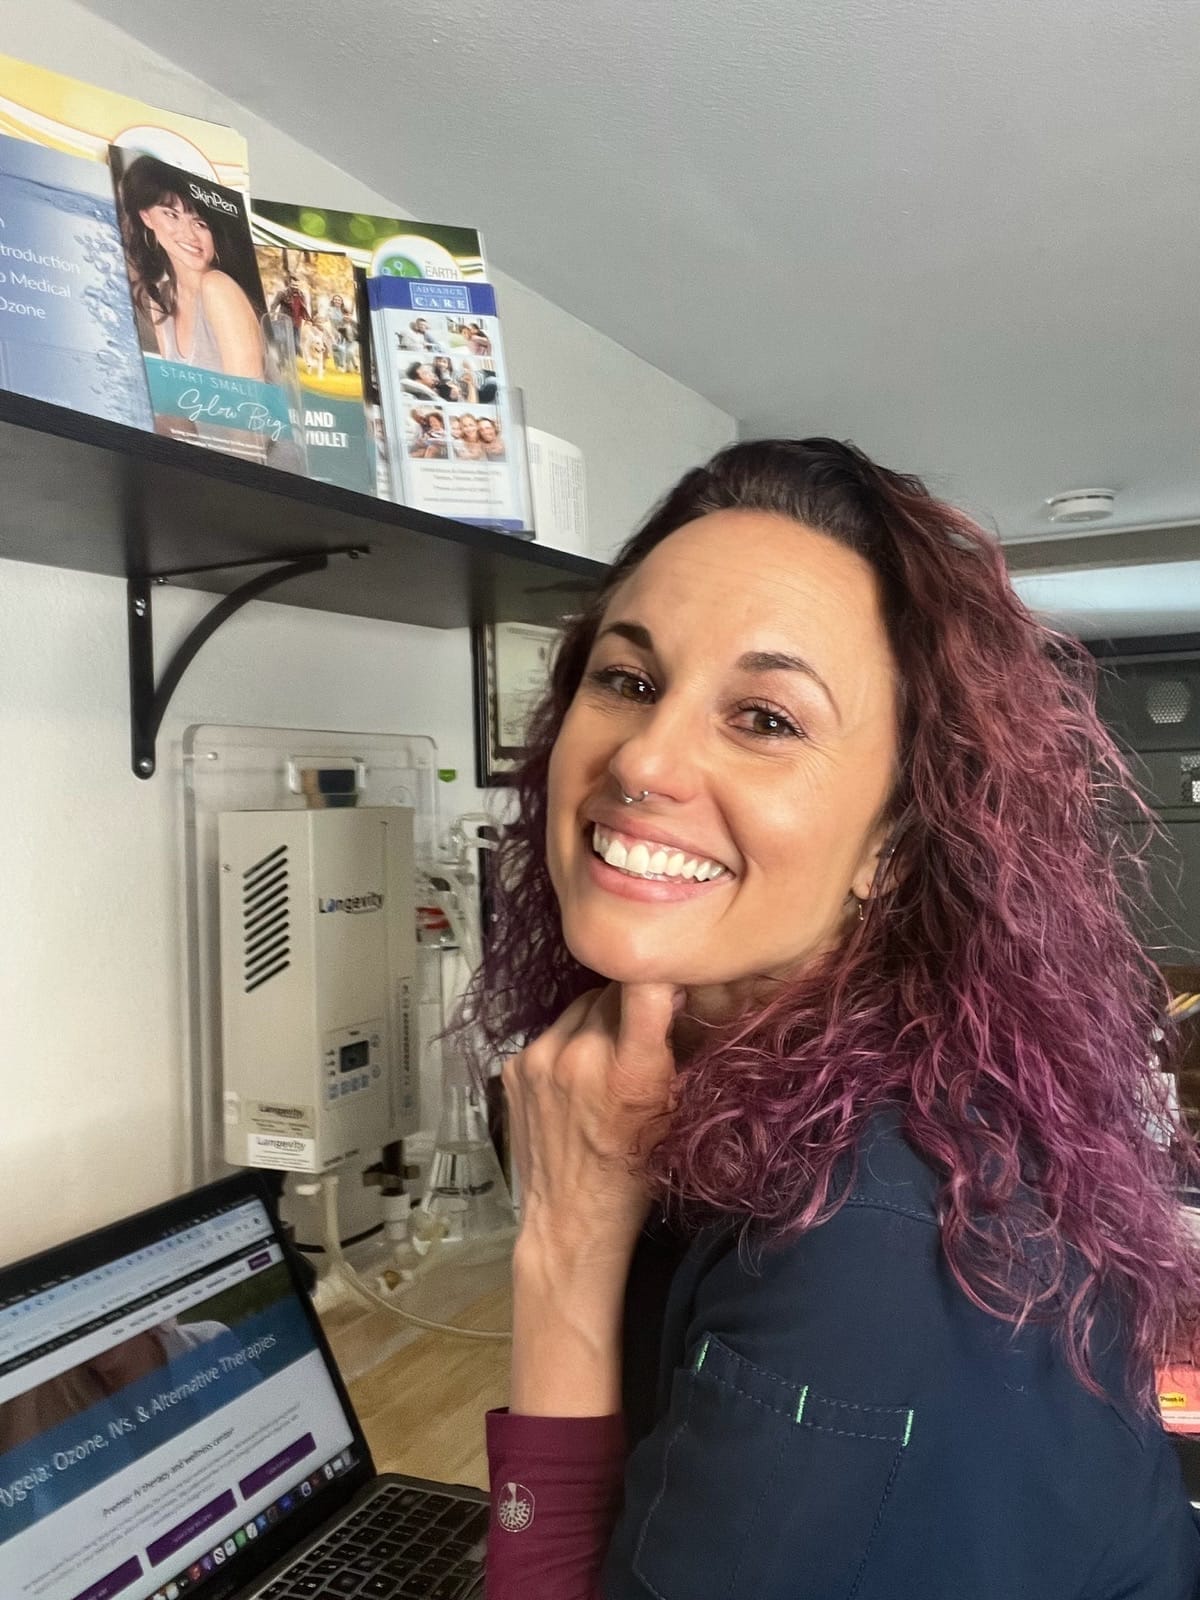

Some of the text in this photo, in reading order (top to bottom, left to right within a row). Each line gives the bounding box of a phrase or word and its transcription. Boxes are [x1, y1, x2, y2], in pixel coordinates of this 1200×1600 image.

[189, 183, 239, 215] SkinPen
[425, 265, 458, 280] EARTH
[10, 269, 72, 298] Medical
[415, 285, 464, 297] ADVANCE
[414, 296, 467, 309] CARE
[160, 365, 204, 384] START
[177, 388, 239, 422] Glow
[236, 401, 288, 442] Big
[304, 409, 336, 428] AND
[318, 891, 384, 915] Longevity
[0, 1463, 54, 1508] ygeia:
[52, 1433, 110, 1471] Ozone,
[135, 1405, 151, 1423] &
[151, 1366, 221, 1416] Alternative
[218, 1333, 277, 1374] Therapies
